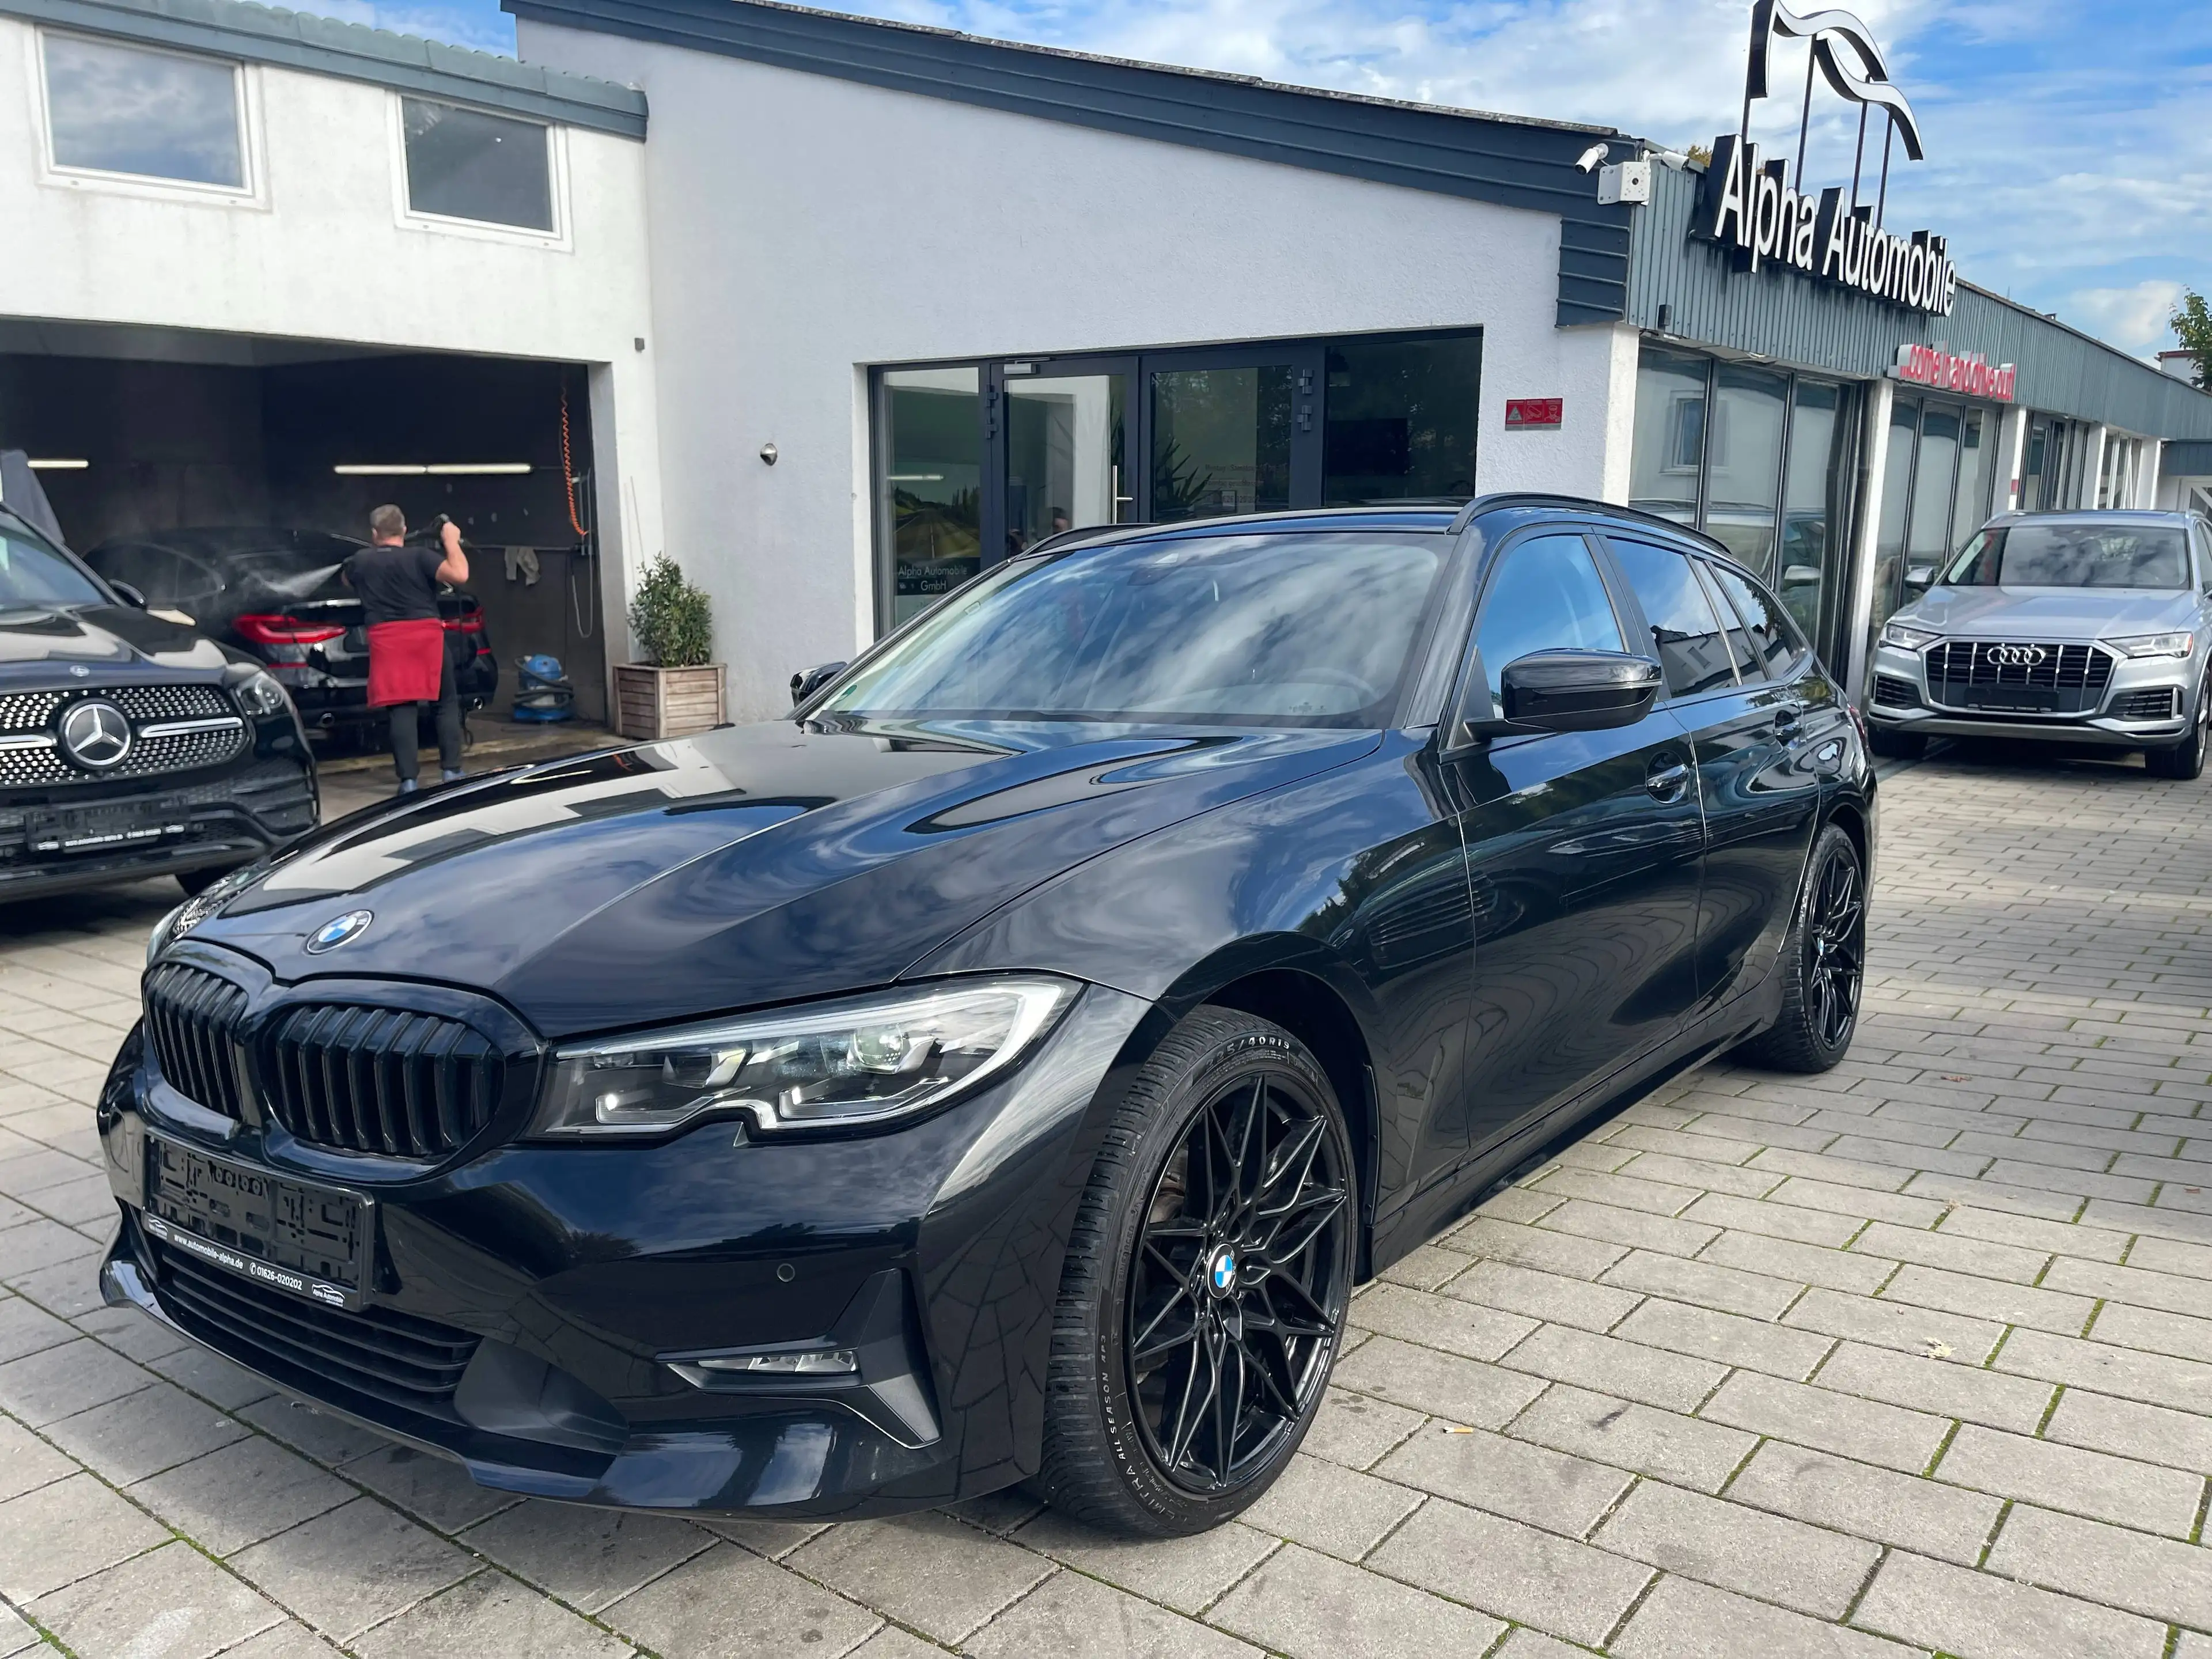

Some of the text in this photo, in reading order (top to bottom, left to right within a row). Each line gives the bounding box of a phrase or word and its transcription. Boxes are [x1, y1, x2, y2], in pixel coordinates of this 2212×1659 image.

[1714, 134, 1956, 316] Alpha Automobile
[898, 565, 968, 578] Alpha Automobile
[921, 579, 946, 591] GmbH
[174, 1234, 244, 1269] www.automobile-alpha.de
[257, 1266, 302, 1290] 01626-020202
[1102, 1372, 1117, 1434] SEASON
[1114, 1439, 1126, 1460] ALL
